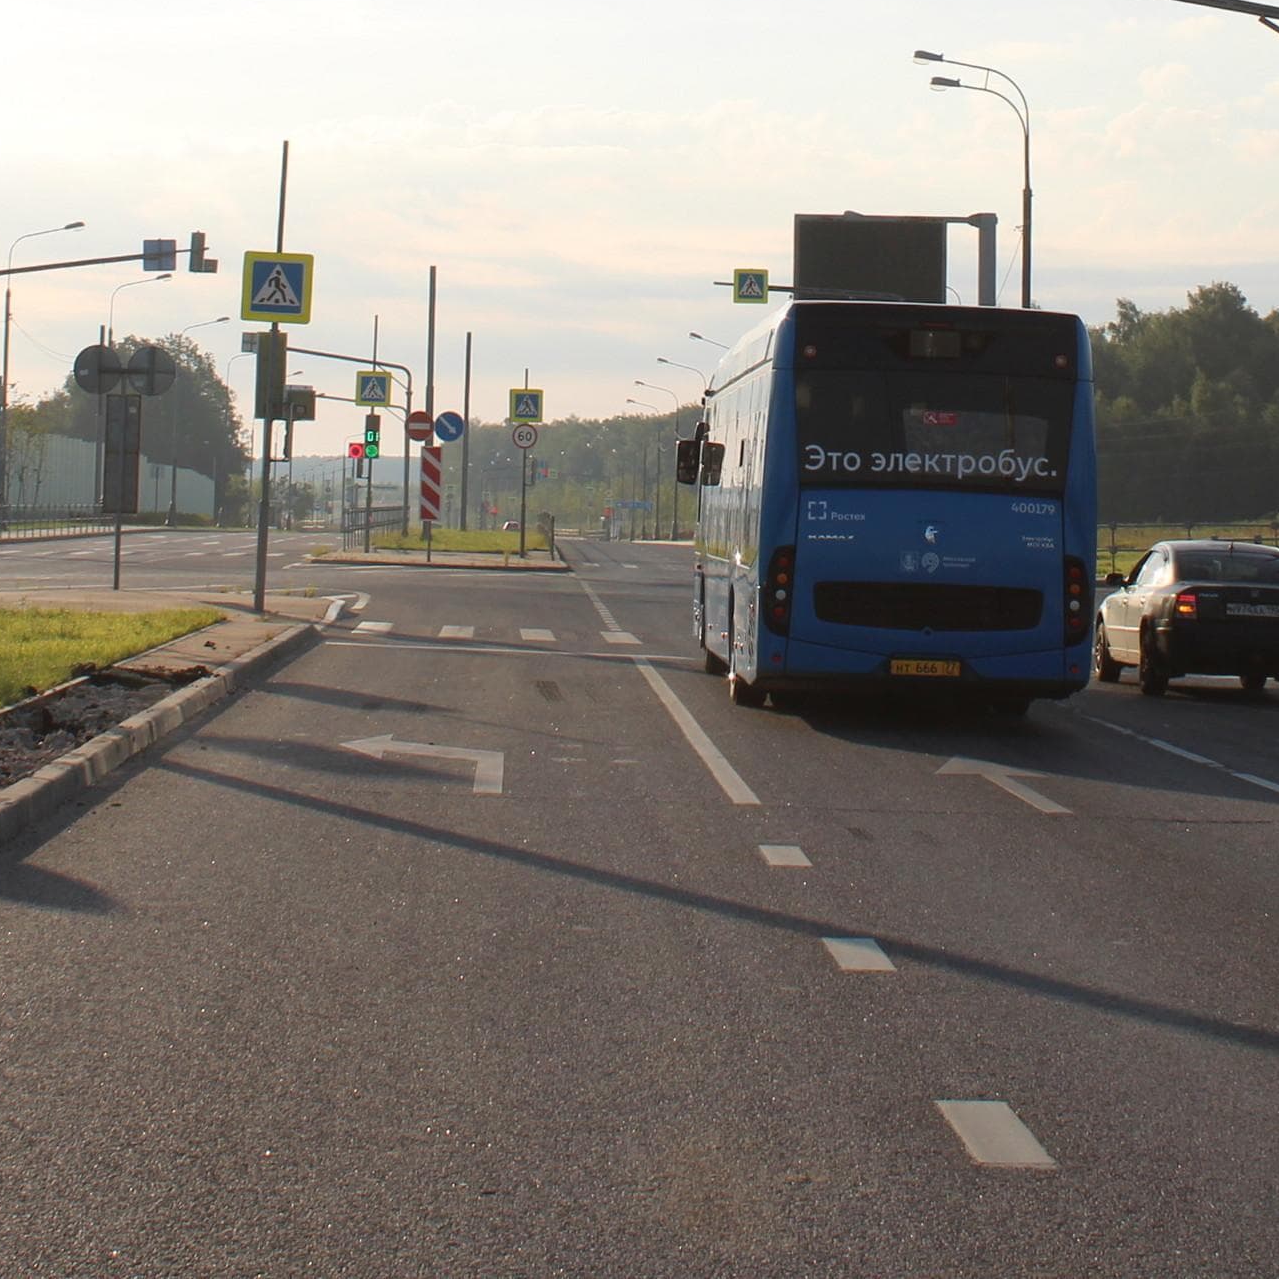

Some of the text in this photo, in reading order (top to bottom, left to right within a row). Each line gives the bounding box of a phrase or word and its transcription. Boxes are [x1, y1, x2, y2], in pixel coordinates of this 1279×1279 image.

[518, 431, 532, 442] 60
[805, 444, 1058, 481] Это электробус.
[1012, 502, 1055, 515] 400179
[831, 512, 866, 522] Ростех
